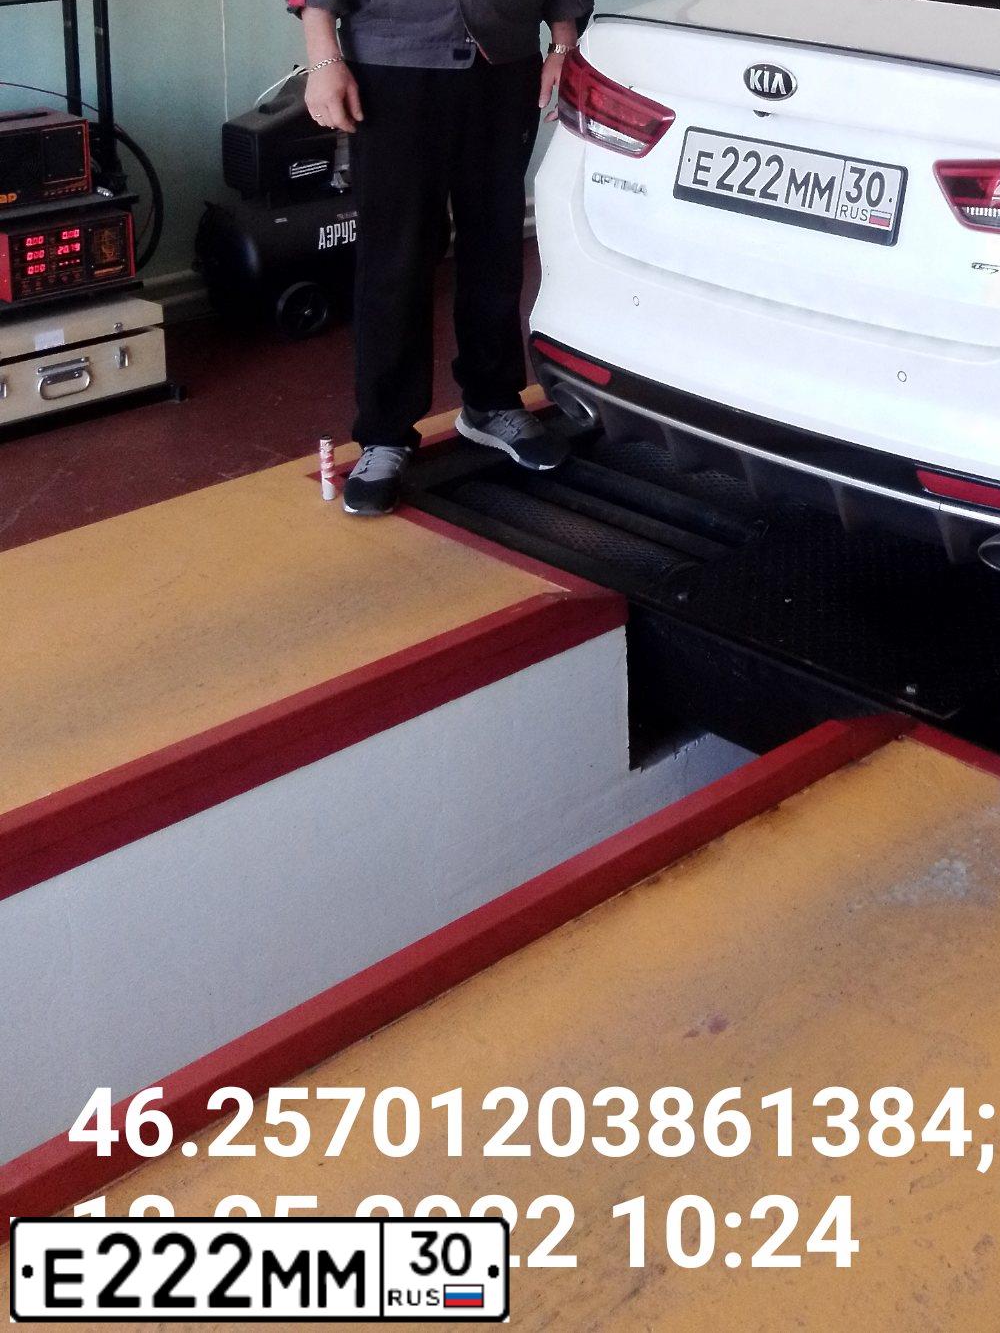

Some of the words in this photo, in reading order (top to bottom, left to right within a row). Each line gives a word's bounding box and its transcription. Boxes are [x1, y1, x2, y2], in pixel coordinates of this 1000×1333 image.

[749, 68, 787, 95] KIA
[845, 165, 886, 208] 30
[840, 204, 868, 222] RUS
[318, 219, 357, 250] АЭРУС
